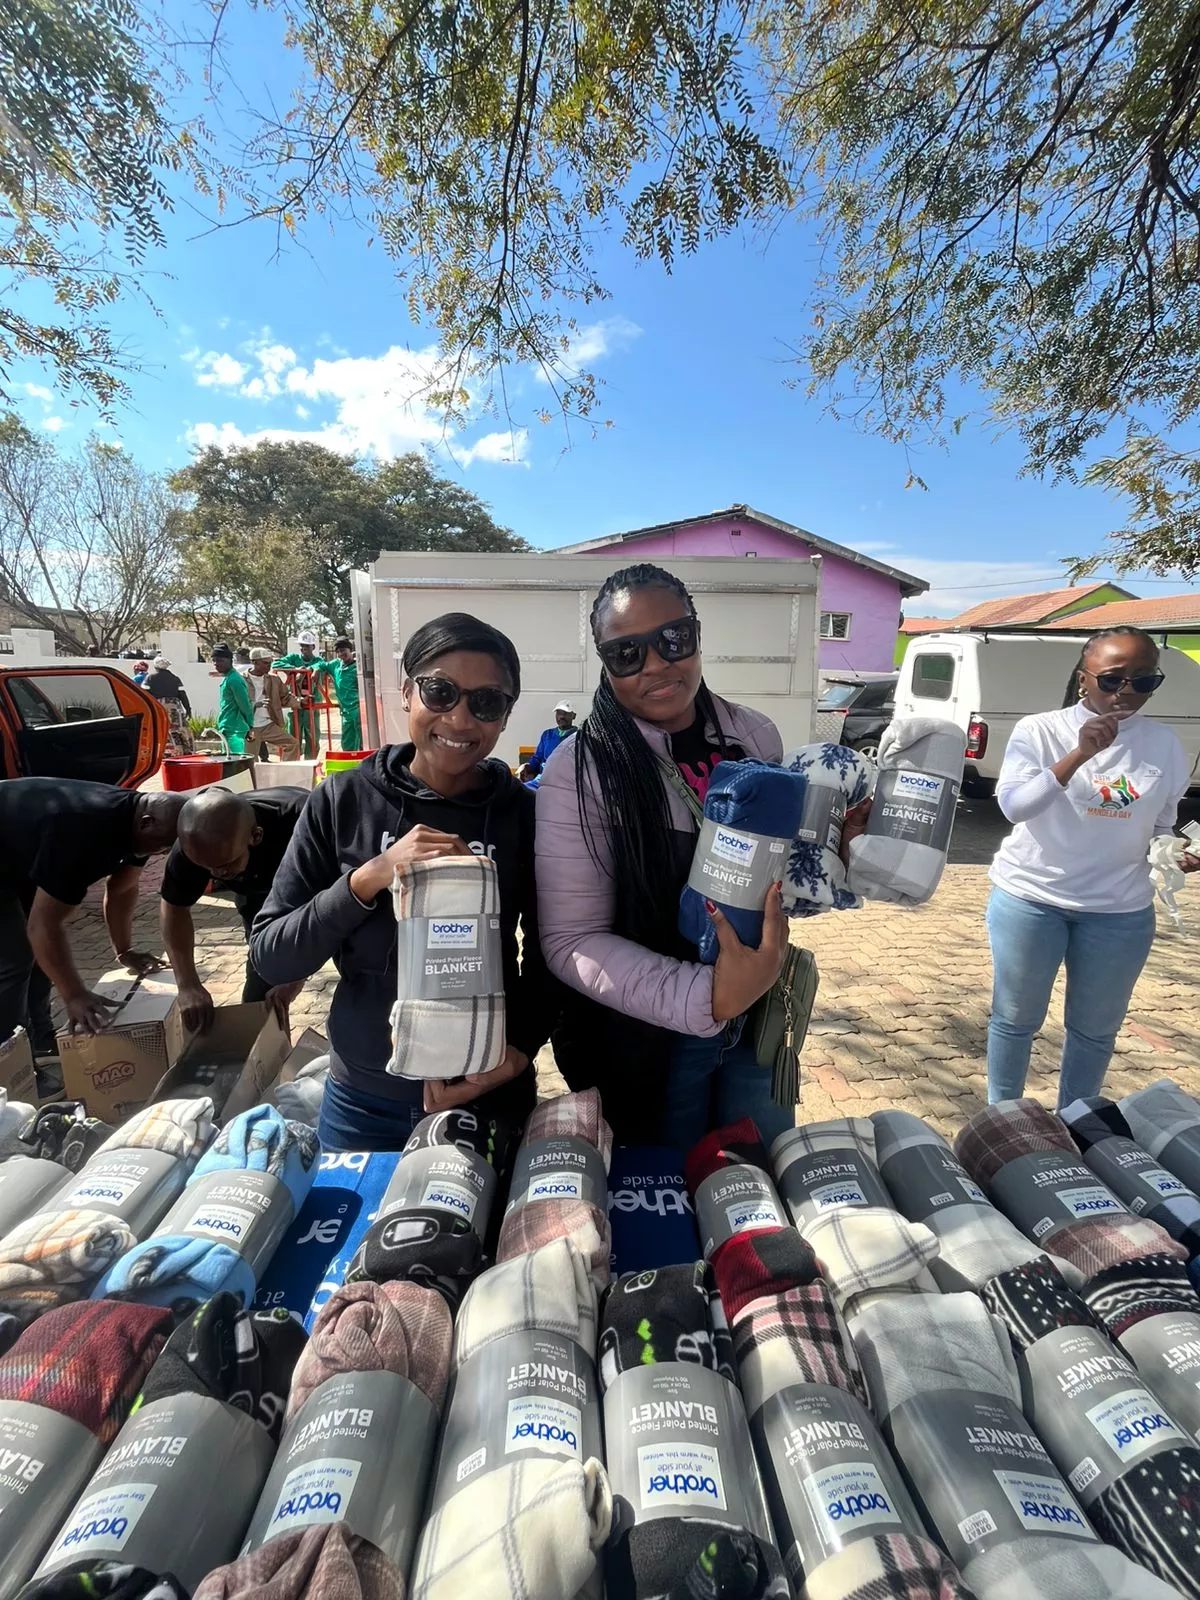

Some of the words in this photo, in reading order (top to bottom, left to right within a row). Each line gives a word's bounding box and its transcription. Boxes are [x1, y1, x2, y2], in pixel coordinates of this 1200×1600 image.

[900, 775, 940, 789] brother
[882, 807, 937, 825] BLANKET
[718, 832, 753, 851] brother
[702, 863, 753, 888] BLANKET
[432, 923, 474, 933] brother
[425, 961, 483, 975] BLANKET
[93, 1063, 134, 1085] MAQ
[528, 1152, 587, 1167] BLANKET
[428, 1161, 485, 1187] BLANKET
[622, 1175, 654, 1188] side
[657, 1174, 687, 1186] our
[801, 1163, 857, 1183] BLANKET
[1032, 1166, 1093, 1185] BLANKET
[208, 1185, 272, 1208] BLANKET
[532, 1184, 577, 1195] brother
[713, 1181, 770, 1202] BLANKET
[427, 1193, 471, 1216] brother
[820, 1192, 863, 1208] brother
[1073, 1199, 1120, 1212] brother
[193, 1217, 242, 1236] brother
[734, 1212, 777, 1226] brother
[1162, 1340, 1200, 1368] NKET
[507, 1362, 587, 1396] BLANKET
[1056, 1355, 1134, 1392] BLANKET
[1093, 1373, 1112, 1386] Polar
[507, 1380, 537, 1390] Fleece
[538, 1380, 560, 1391] Polar
[1067, 1381, 1093, 1399] Fleece
[629, 1400, 718, 1426] BLANKET
[288, 1408, 374, 1455] BLANKET
[333, 1427, 368, 1439] Printed
[631, 1421, 660, 1434] Fleece
[662, 1420, 686, 1429] Polar
[688, 1421, 719, 1435] Printed
[1113, 1413, 1175, 1449] brother
[512, 1422, 577, 1450] brother
[783, 1420, 865, 1458] BLANKET
[965, 1426, 1047, 1453] BLANKET
[817, 1440, 840, 1452] Polar
[841, 1440, 869, 1451] Printed
[974, 1445, 1003, 1455] Fleece
[142, 1454, 176, 1467] Printed
[657, 1463, 674, 1472] side
[674, 1461, 693, 1471] your
[0, 1471, 30, 1495] Printe
[647, 1473, 718, 1498] brother
[827, 1486, 843, 1499] side
[272, 1491, 342, 1523] brother
[826, 1493, 891, 1520] brothe
[1019, 1500, 1086, 1529] brother
[57, 1517, 129, 1551] brother
